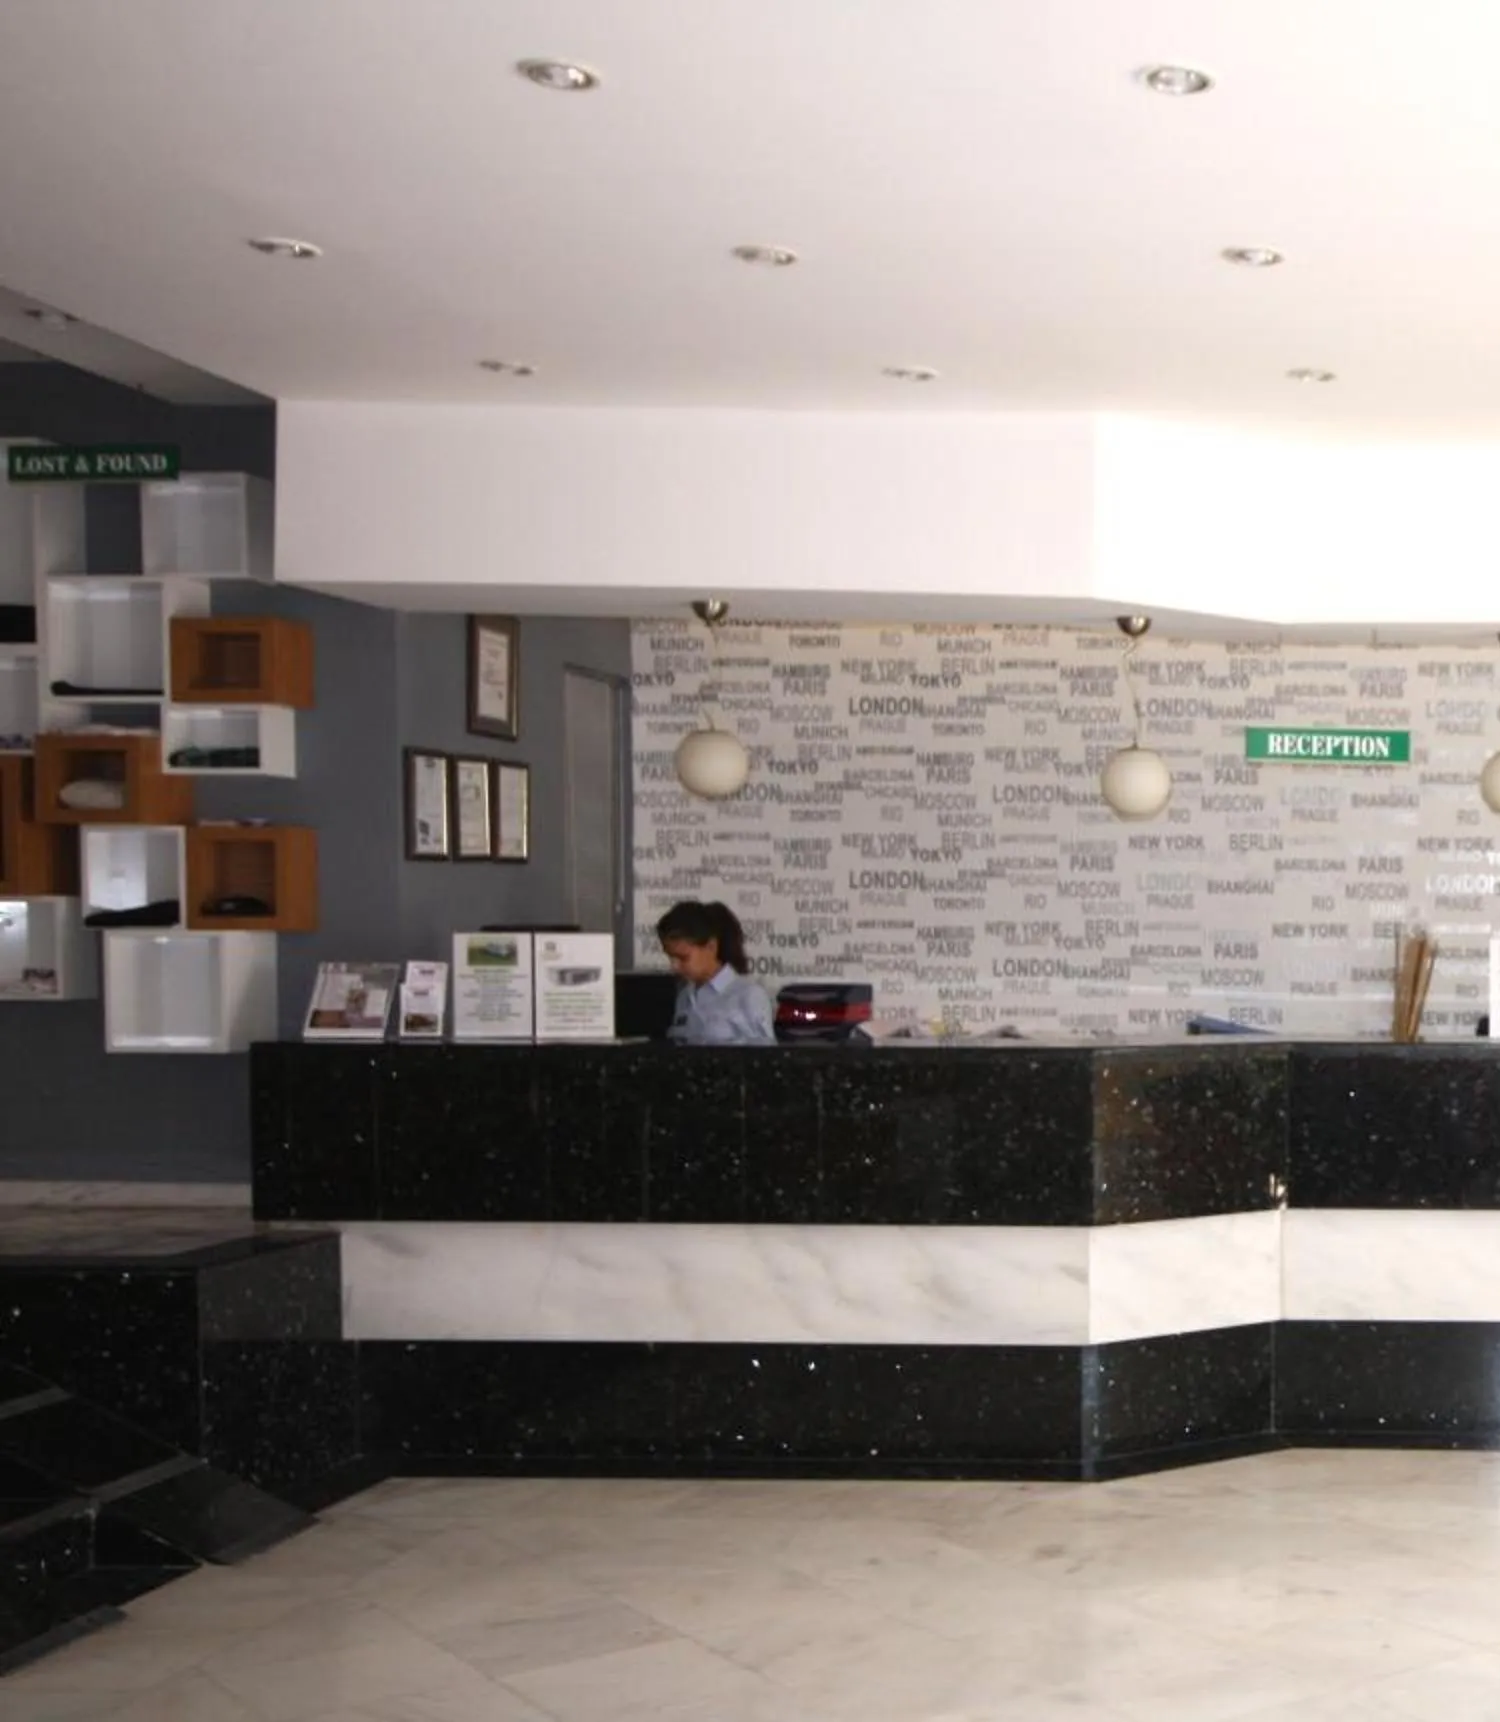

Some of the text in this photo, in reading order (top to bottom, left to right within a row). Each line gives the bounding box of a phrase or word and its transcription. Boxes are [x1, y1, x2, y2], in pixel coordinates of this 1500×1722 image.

[15, 452, 168, 474] LOST & FOUND
[651, 638, 704, 651] MUNICH
[937, 639, 991, 653] MUNICH
[841, 659, 916, 675] NEW YORK
[941, 657, 995, 675] BERLIN
[1128, 660, 1204, 677] NEW YORK
[1418, 661, 1450, 677] NEW
[783, 680, 827, 697] PARIS
[910, 674, 961, 688] TOKYO
[986, 683, 1057, 695] BARCELONA
[1198, 676, 1249, 690] TOKYO
[1070, 682, 1114, 698] PARIS
[1275, 684, 1346, 696] BARCELONA
[1360, 683, 1404, 700] PARIS
[849, 697, 924, 717] LONDON
[921, 704, 987, 719] SHANGHAI
[1056, 707, 1121, 723] MOSCOW
[1209, 706, 1275, 720] SHANGHAI
[794, 725, 848, 739] MUNICH
[798, 743, 852, 761] BERLIN
[1267, 732, 1391, 758] RECEPTION
[985, 747, 1060, 763] NEW YORK
[767, 760, 818, 775] TOKYO
[843, 769, 914, 781] BARCELONA
[927, 768, 971, 785] PARIS
[1215, 770, 1259, 786] PARIS
[778, 790, 844, 805] SHANGHAI
[913, 793, 977, 810] MOSCOW
[993, 785, 1068, 805] LONDON
[938, 813, 992, 827] MUNICH
[842, 833, 916, 849] NEW YORK
[942, 831, 996, 849] BERLIN
[1129, 835, 1161, 850] NEW
[701, 854, 771, 867] BARCELONA
[784, 854, 828, 870] PARIS
[910, 848, 961, 862] TOKYO
[987, 857, 1058, 869] BARCELONA
[1071, 856, 1115, 873] PARIS
[850, 870, 924, 891] LONDON
[921, 878, 987, 892] SHANGHAI
[1057, 881, 1121, 897] MOSCOW
[795, 899, 849, 912] MUNICH
[799, 917, 853, 934] BERLIN
[985, 920, 1060, 937] NEW YORK
[768, 933, 818, 948] TOKYO
[844, 942, 915, 954] BARCELONA
[1054, 936, 1105, 950] TOKYO
[927, 942, 971, 958] PARIS
[1131, 944, 1201, 957] BARCELONA
[1214, 944, 1258, 960] PARIS
[993, 958, 1068, 979] LONDON
[1065, 966, 1131, 980] SHANGHAI
[939, 986, 992, 1000] MUNICH
